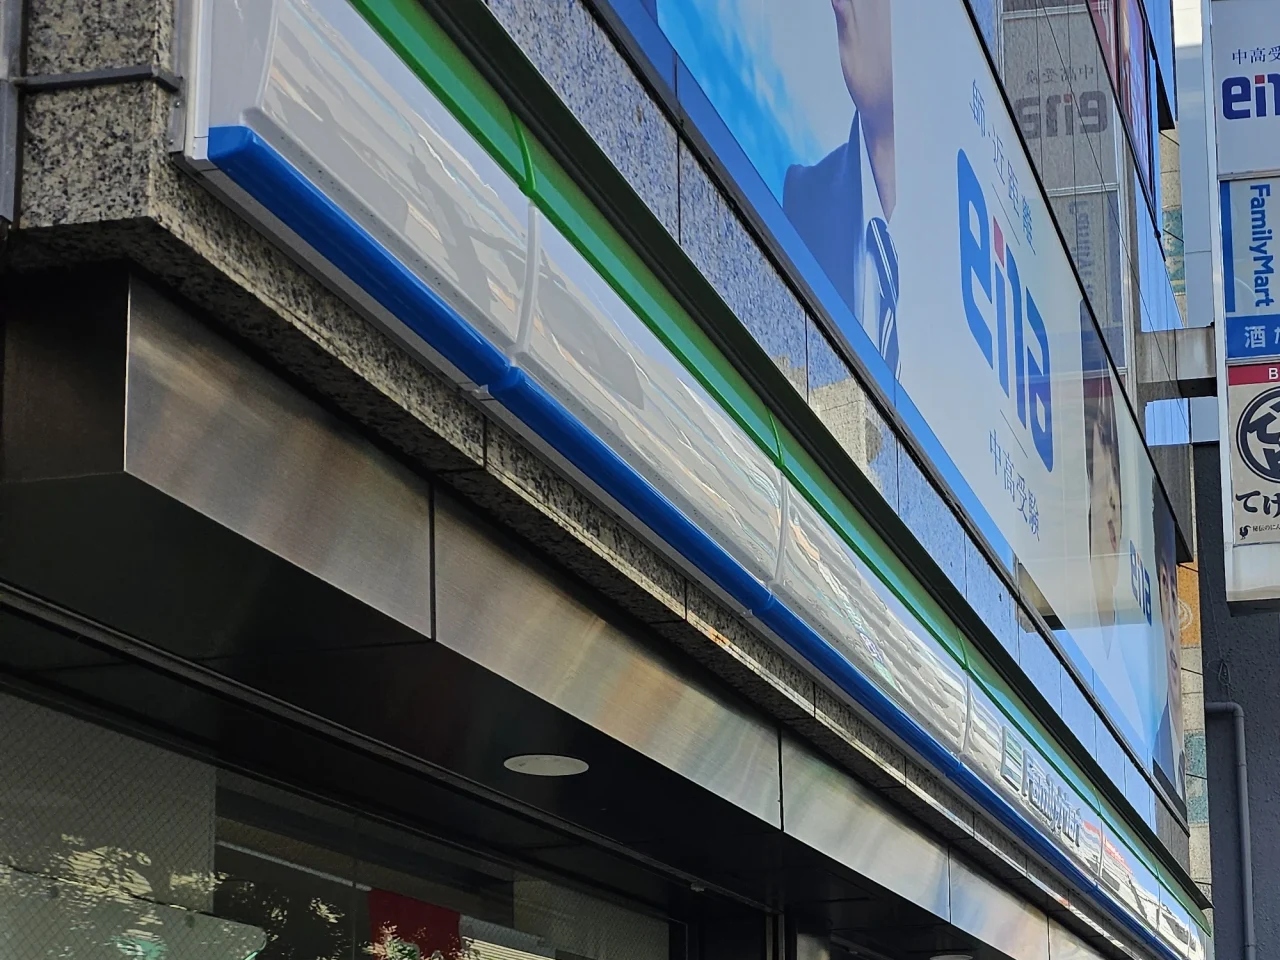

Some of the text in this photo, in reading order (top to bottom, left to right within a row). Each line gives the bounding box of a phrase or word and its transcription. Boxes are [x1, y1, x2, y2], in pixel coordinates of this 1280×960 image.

[1249, 184, 1275, 307] FamilyMart
[957, 148, 1054, 473] ena
[1244, 326, 1265, 348] 酒
[989, 428, 1040, 543] 中高受験
